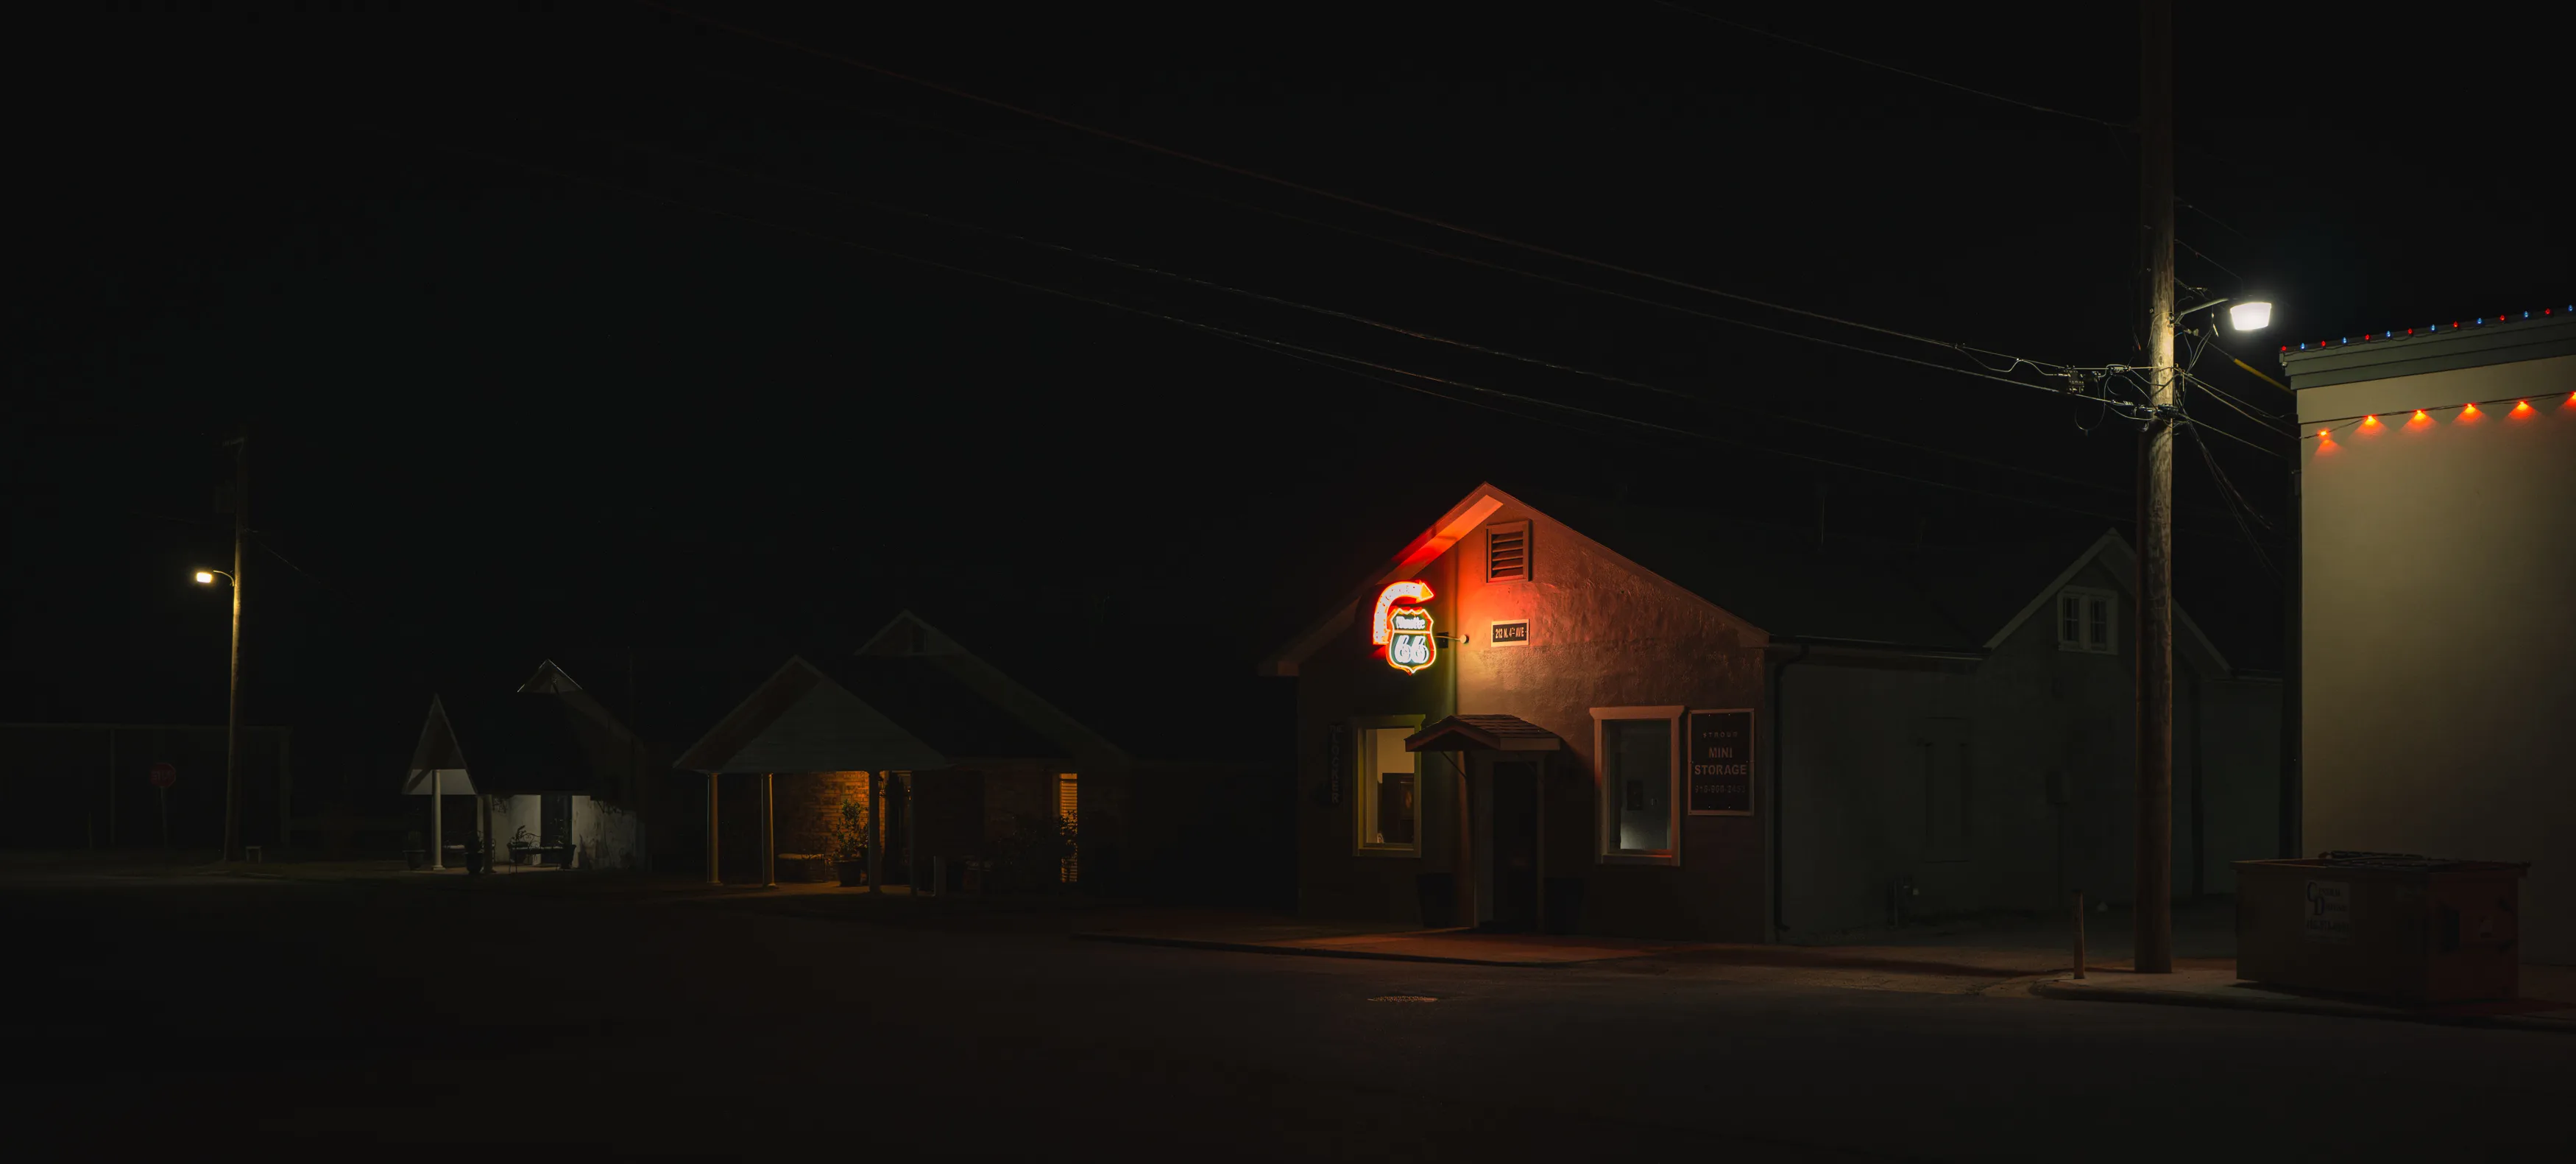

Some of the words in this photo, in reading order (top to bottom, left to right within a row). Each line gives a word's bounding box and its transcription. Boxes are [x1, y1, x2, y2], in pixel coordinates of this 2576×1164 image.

[1515, 627, 1524, 637] AVE
[1395, 635, 1429, 663] 66
[1708, 747, 1733, 758] MINI
[1694, 764, 1747, 775] STORAGE
